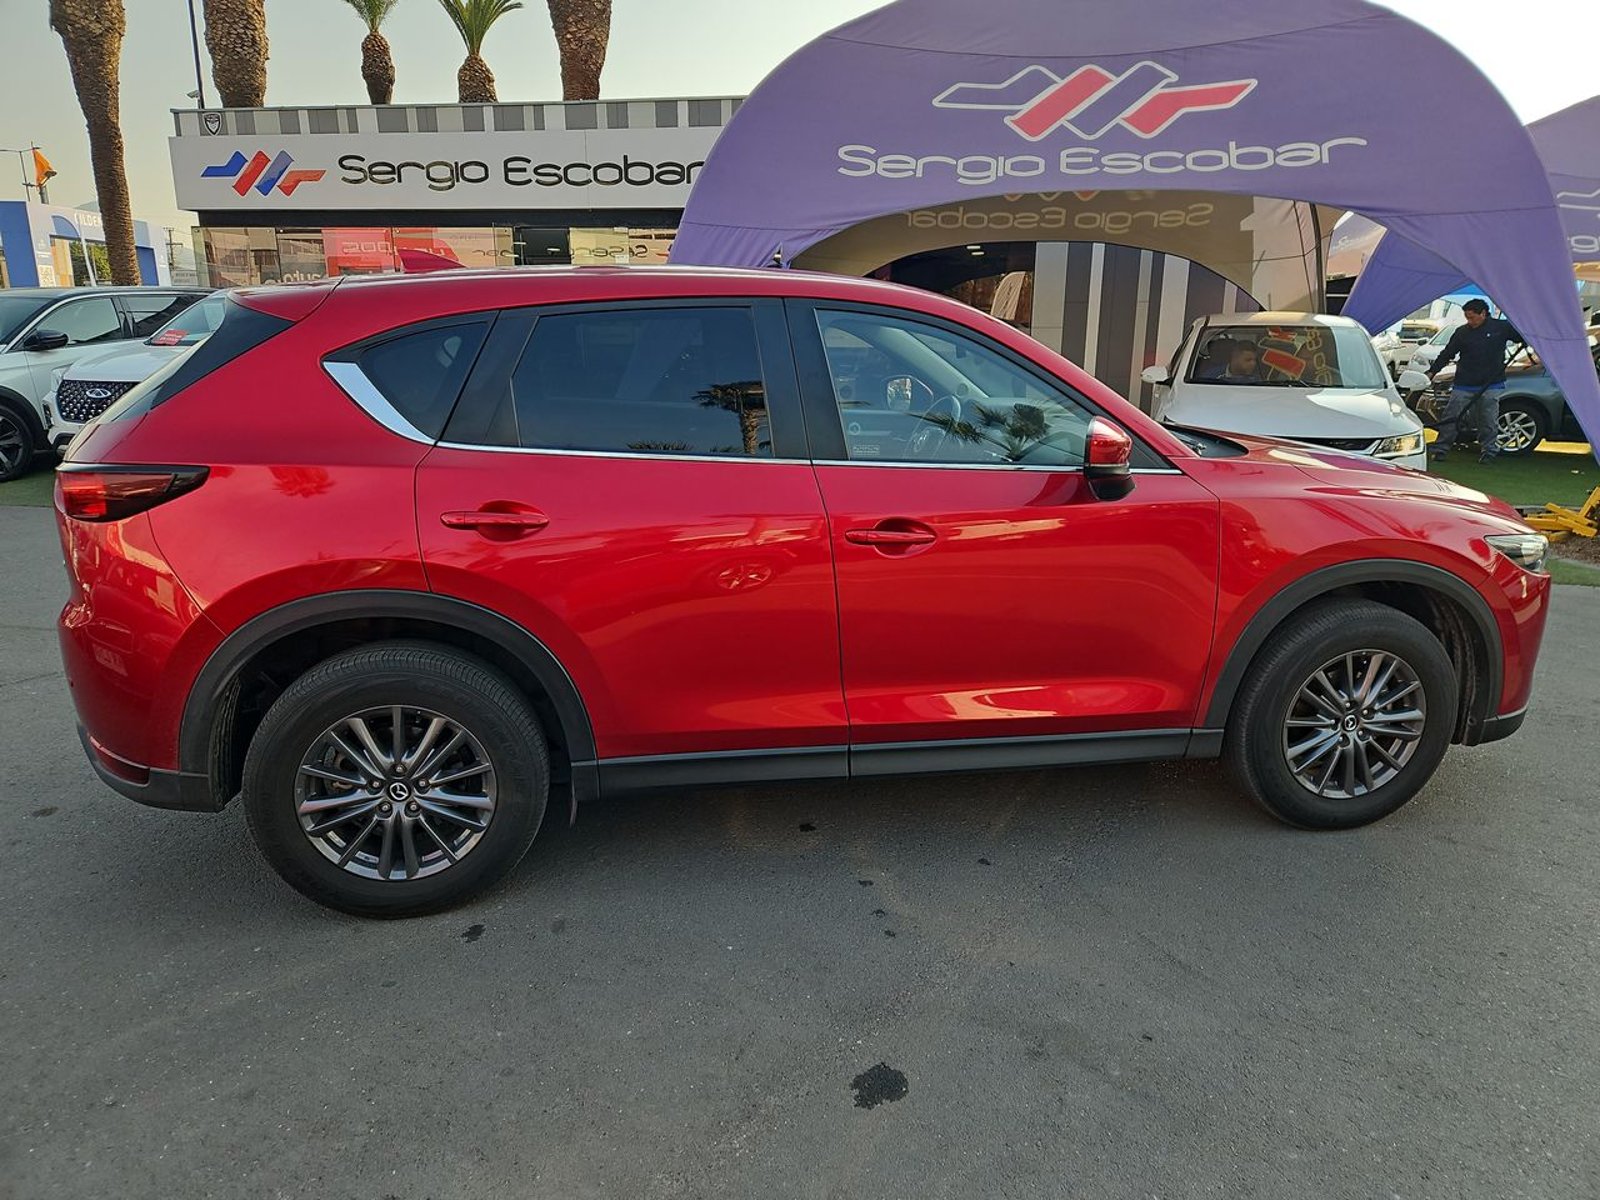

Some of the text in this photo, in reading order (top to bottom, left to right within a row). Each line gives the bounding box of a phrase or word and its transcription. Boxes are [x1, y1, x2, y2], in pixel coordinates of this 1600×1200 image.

[339, 154, 705, 190] Sergio Escobar
[837, 137, 1367, 184] Sergio Escobar
